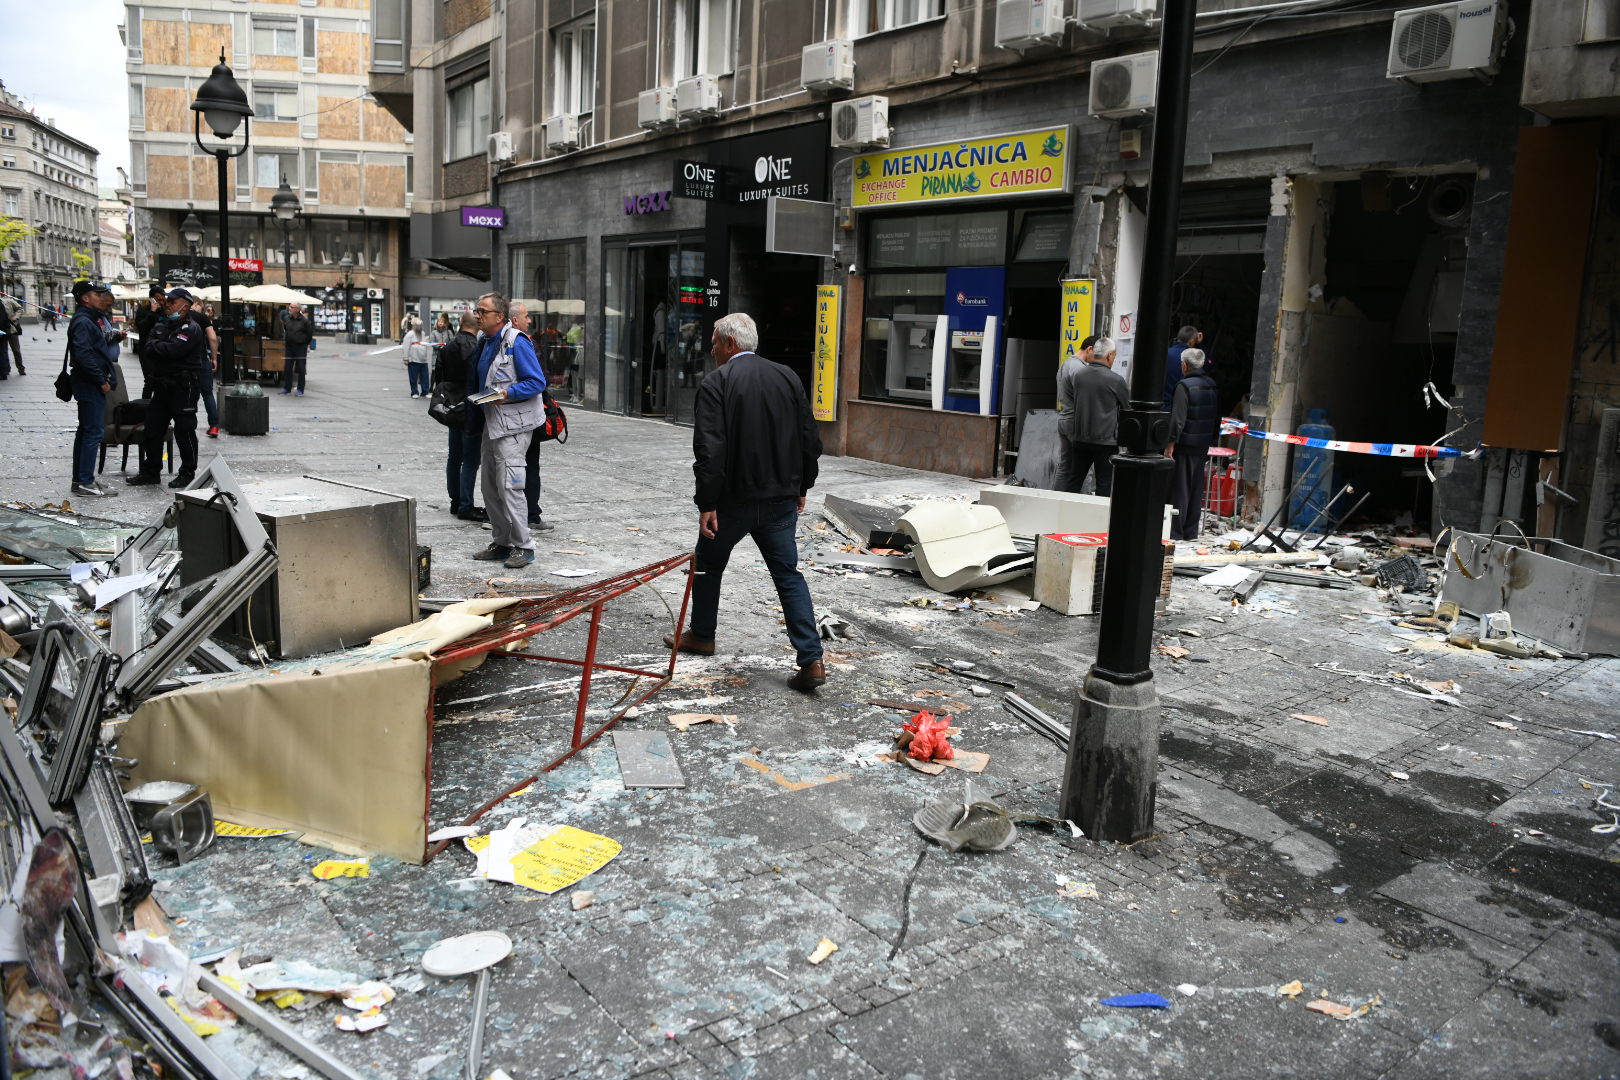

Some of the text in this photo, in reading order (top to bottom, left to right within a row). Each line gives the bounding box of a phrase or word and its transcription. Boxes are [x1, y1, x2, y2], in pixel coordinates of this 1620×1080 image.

[882, 141, 1028, 177] MENJAČNICA
[684, 163, 716, 183] ONE
[754, 155, 792, 183] ONE
[989, 166, 1052, 188] CAMBIO
[685, 182, 714, 191] LUXURY
[685, 189, 714, 199] SUITES
[739, 183, 809, 202] LUXURY SUITES
[861, 178, 907, 193] EXCHANGE
[868, 191, 897, 203] OFFICE
[708, 296, 718, 307] 16
